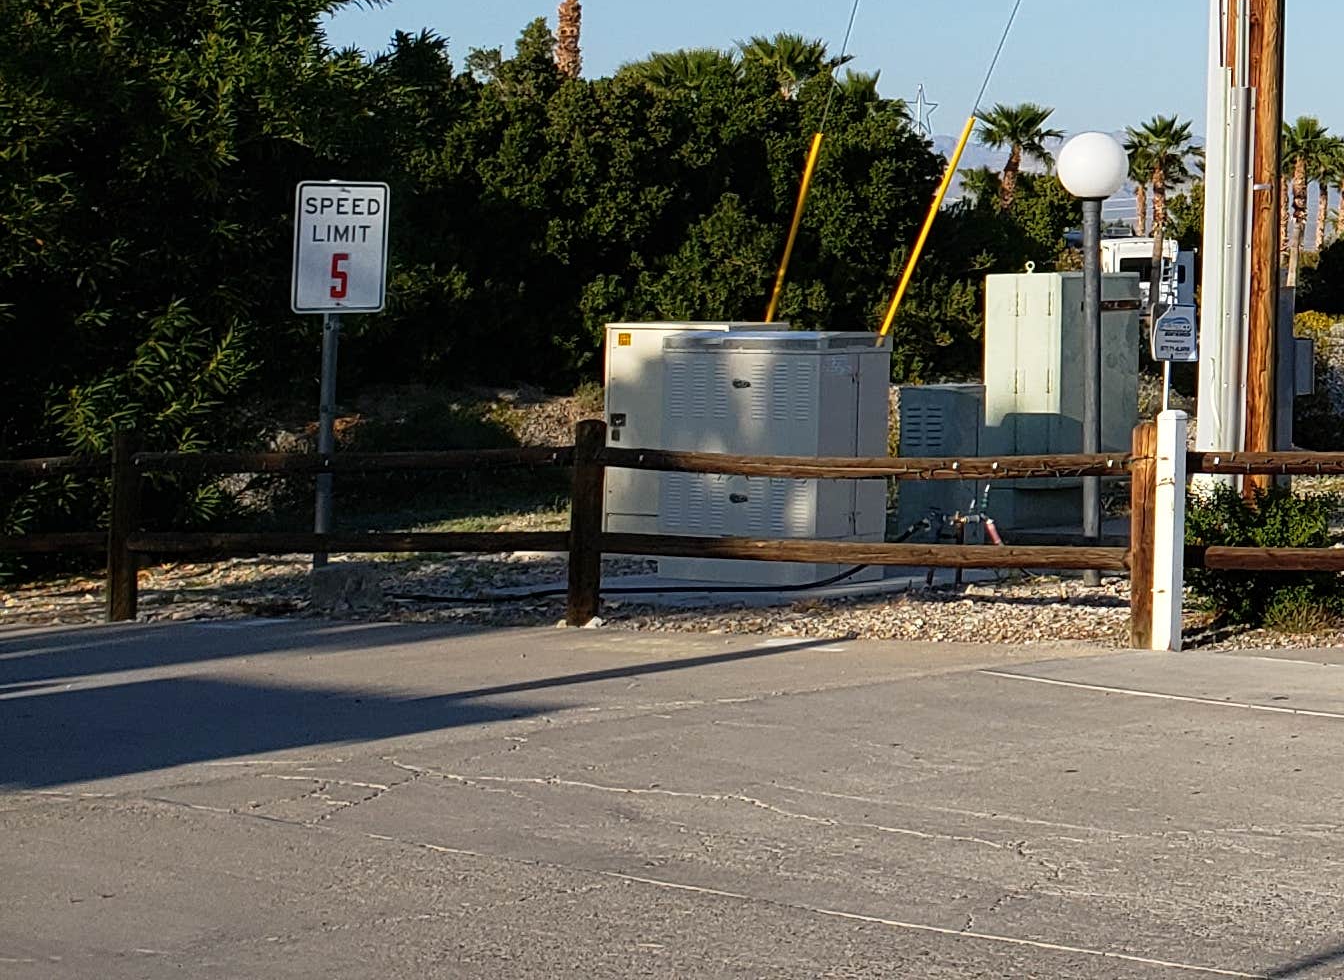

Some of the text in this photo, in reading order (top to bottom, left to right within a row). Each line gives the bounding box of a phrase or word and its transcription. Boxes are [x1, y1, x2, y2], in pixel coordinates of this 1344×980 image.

[305, 197, 381, 215] SPEED
[312, 224, 371, 243] LIMIT
[330, 253, 349, 298] 5
